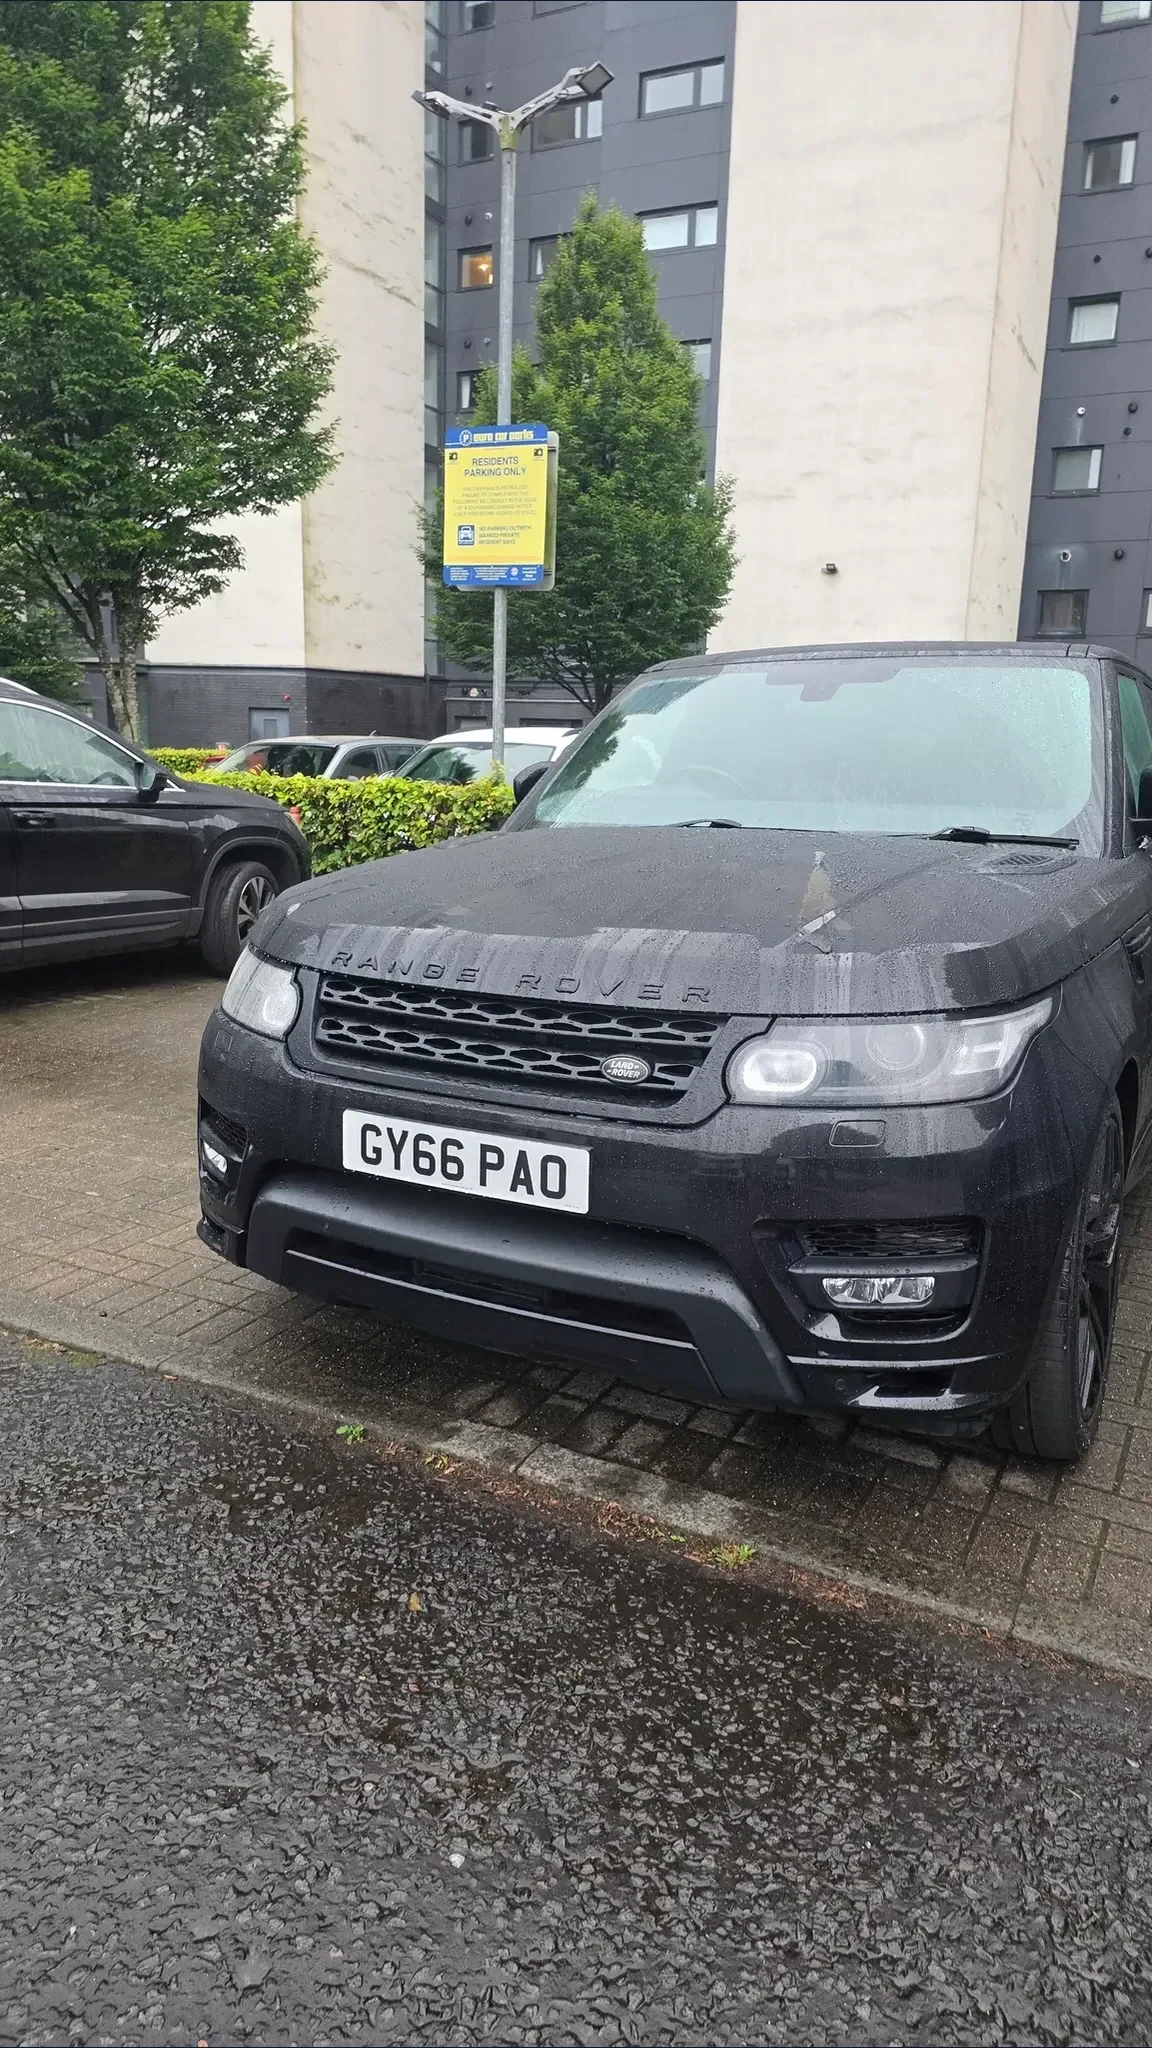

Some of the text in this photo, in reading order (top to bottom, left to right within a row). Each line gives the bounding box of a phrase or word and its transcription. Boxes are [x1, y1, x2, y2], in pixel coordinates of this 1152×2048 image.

[473, 433, 493, 442] euro
[495, 432, 508, 441] car
[509, 429, 534, 441] parks
[472, 456, 519, 466] RESIDENTS
[464, 467, 526, 477] PARKING ONLY
[331, 951, 711, 1003] RANGE ROVER
[610, 1060, 635, 1070] LAND
[611, 1068, 641, 1079] ROVER
[360, 1123, 465, 1182] GY66
